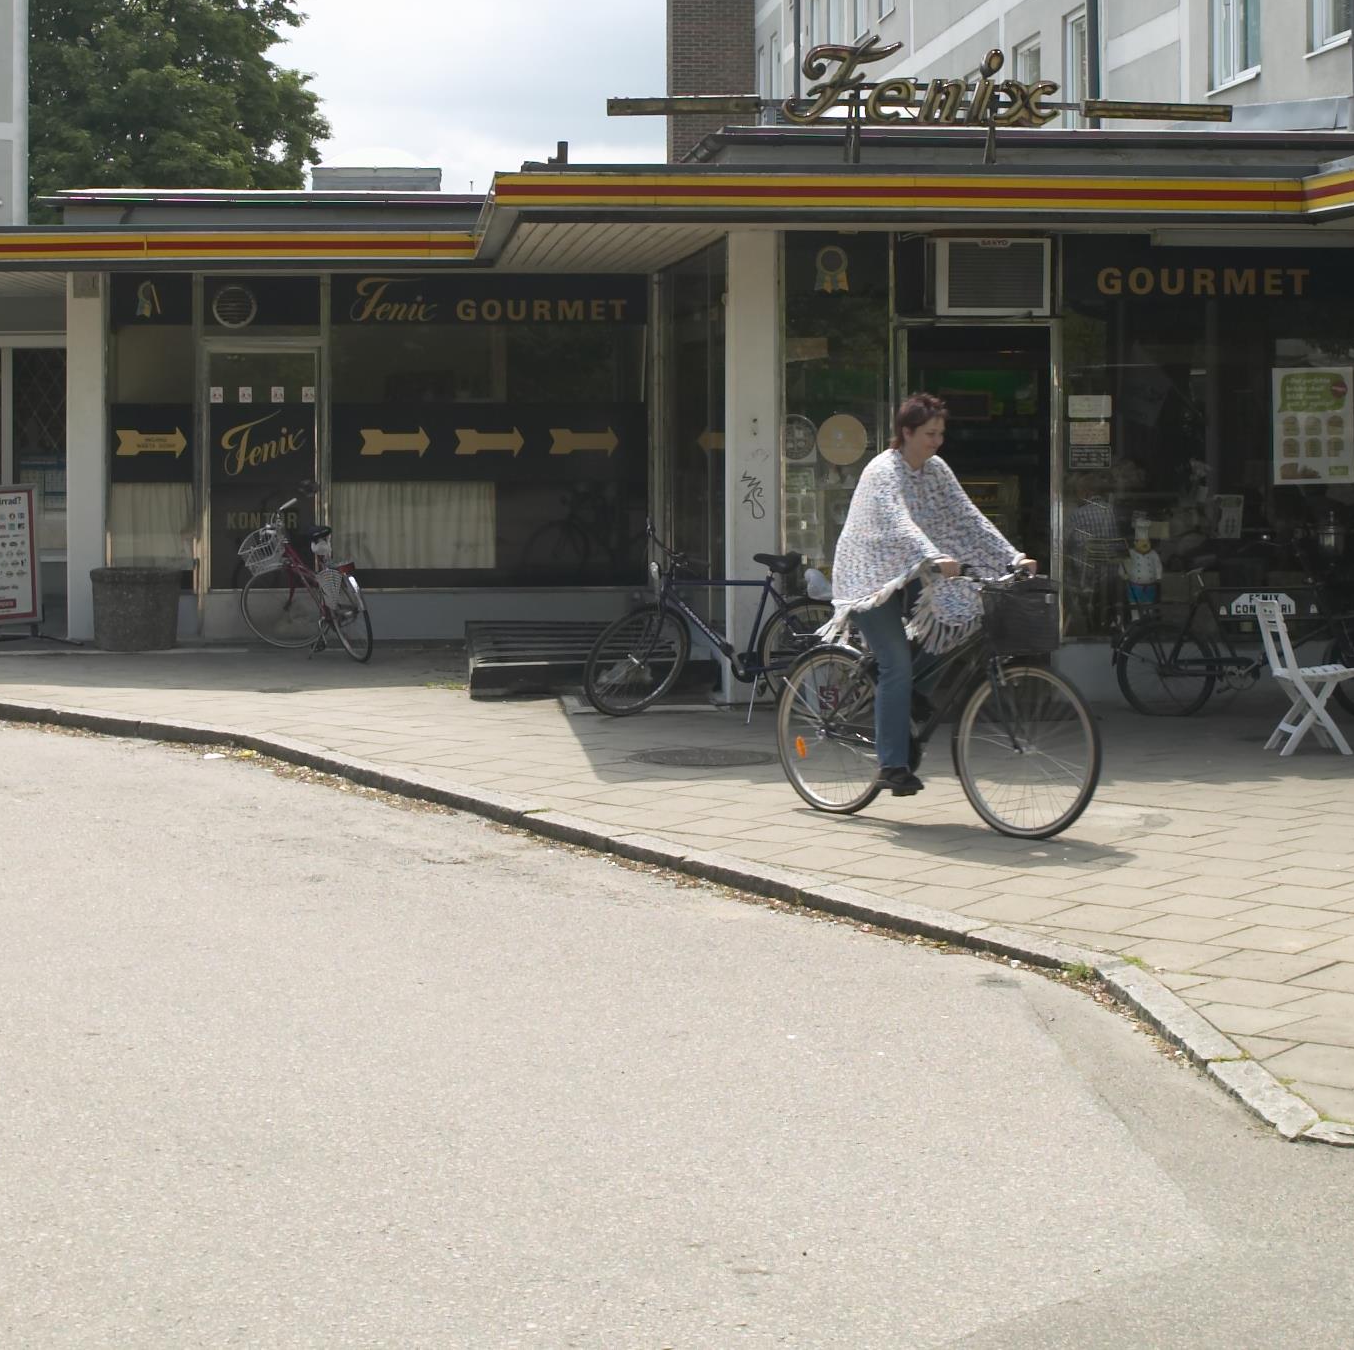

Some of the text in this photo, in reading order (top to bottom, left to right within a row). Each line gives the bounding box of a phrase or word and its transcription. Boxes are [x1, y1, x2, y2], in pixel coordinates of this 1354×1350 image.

[783, 34, 1061, 127] Fenix
[349, 276, 628, 322] Fenix GOURMET
[1095, 266, 1311, 296] GOURMET
[220, 409, 305, 476] Fenix
[226, 511, 298, 530] KONTR
[1235, 603, 1292, 614] CONRI
